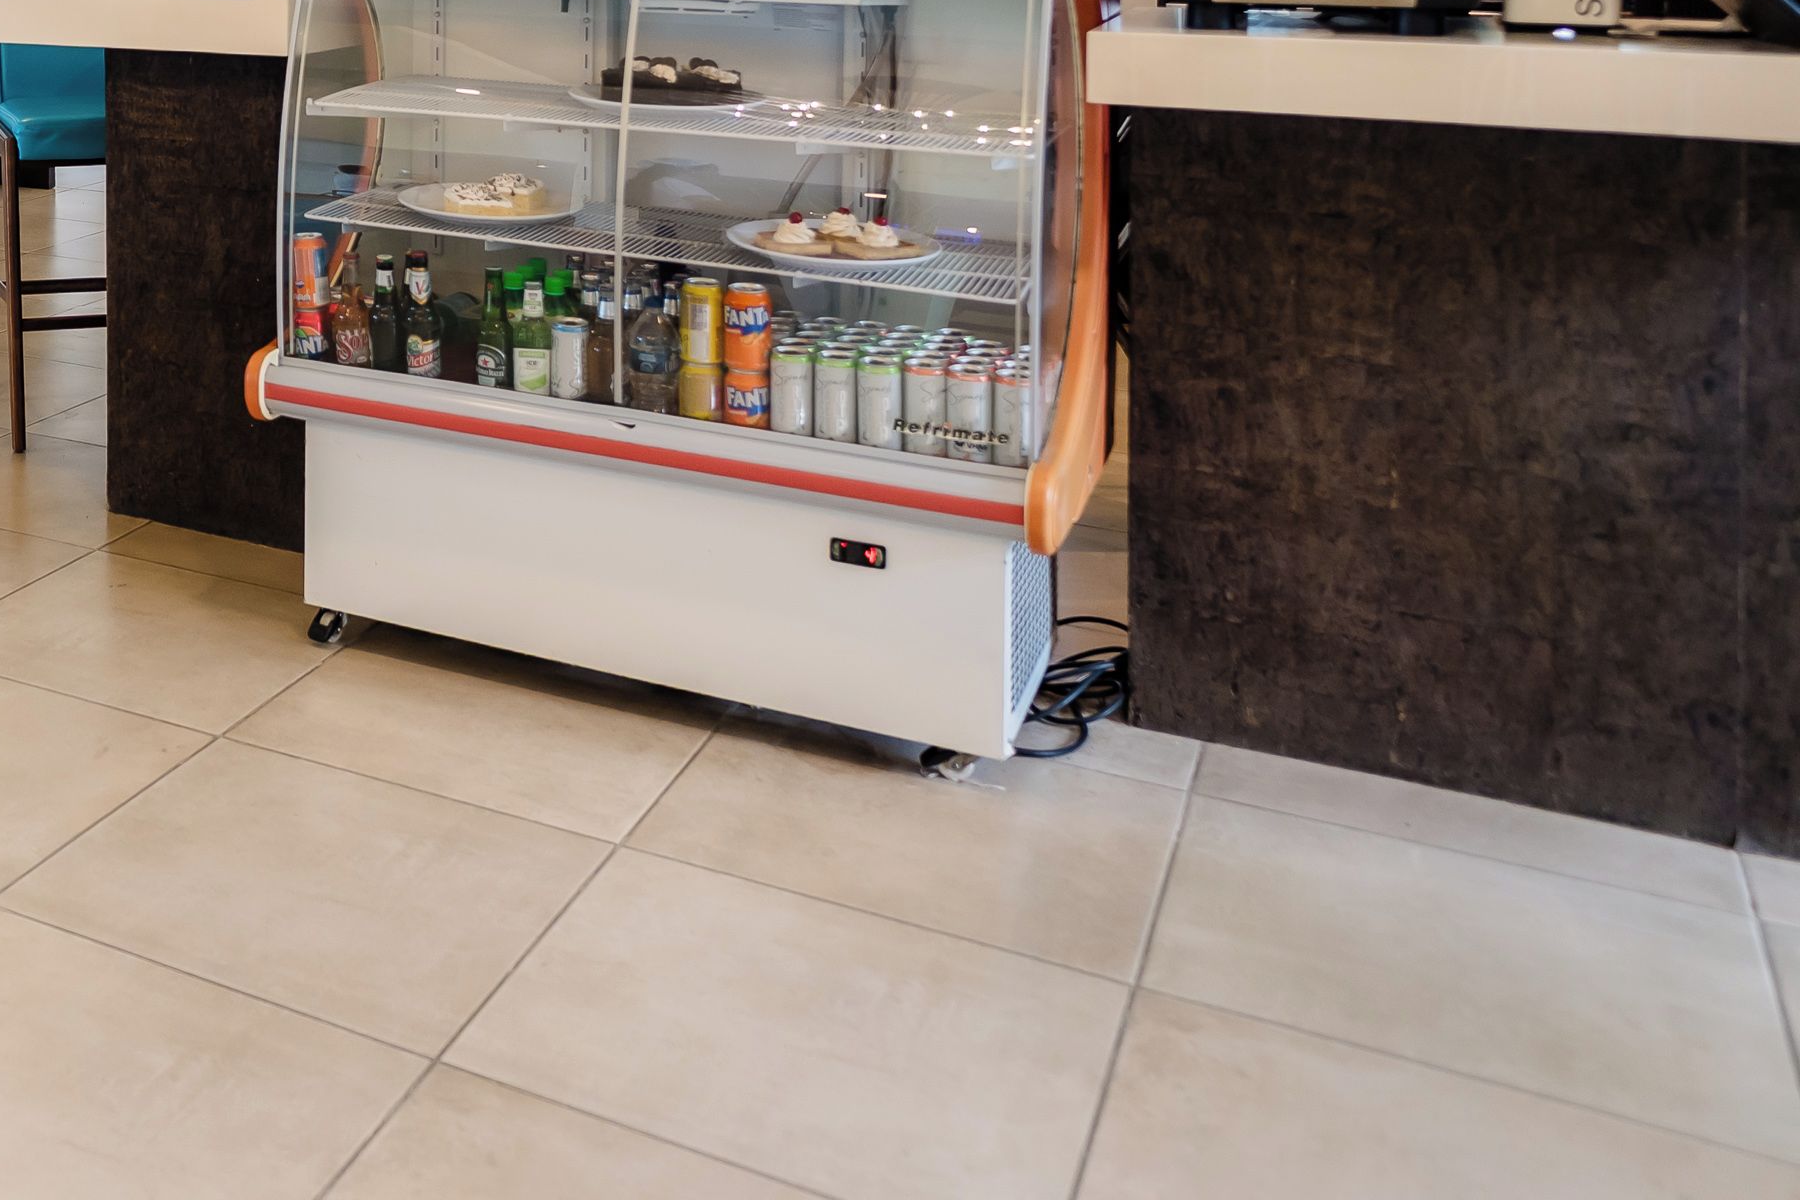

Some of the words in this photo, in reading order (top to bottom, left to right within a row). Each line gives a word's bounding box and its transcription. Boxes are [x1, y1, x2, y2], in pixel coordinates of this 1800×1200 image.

[724, 304, 770, 328] FANTA
[295, 335, 329, 355] ANTA
[726, 386, 769, 408] FANT
[893, 419, 1009, 443] Refrimate
